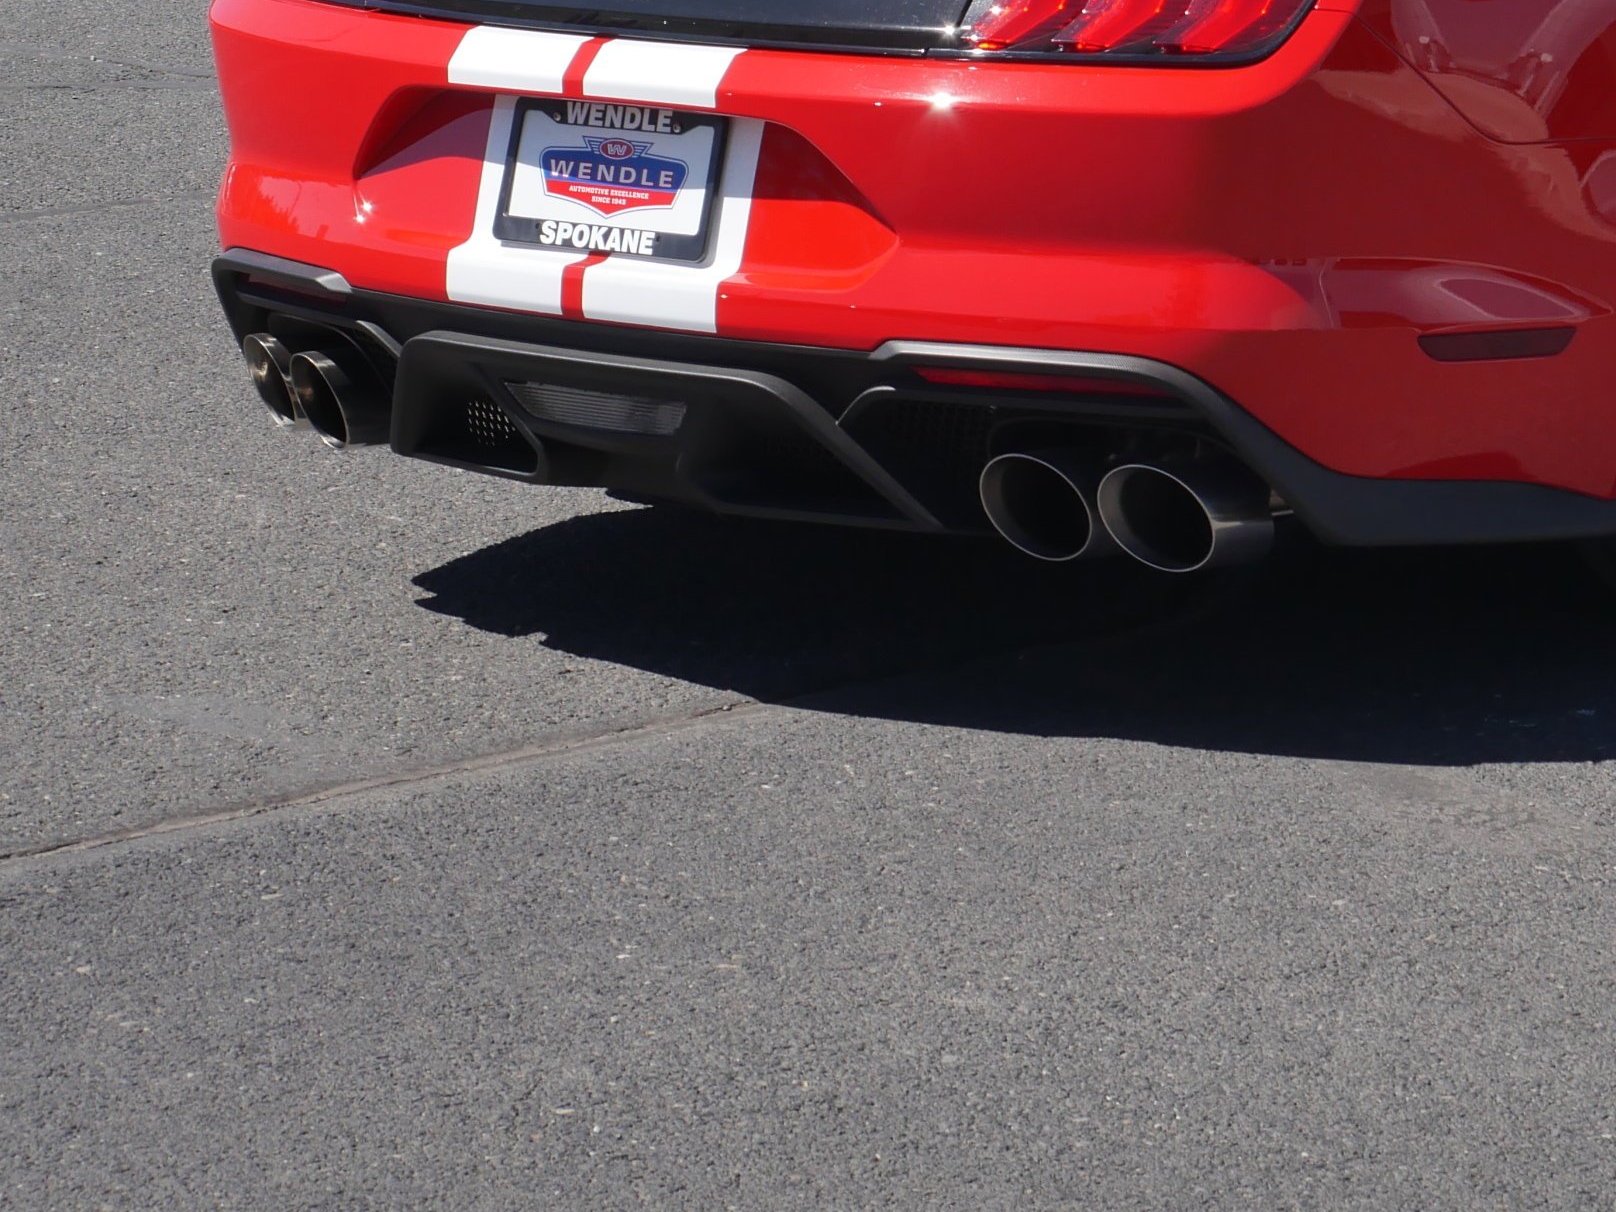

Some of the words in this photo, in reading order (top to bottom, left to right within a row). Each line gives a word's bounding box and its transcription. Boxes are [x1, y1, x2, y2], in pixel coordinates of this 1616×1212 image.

[566, 101, 674, 134] WENDLE
[550, 159, 674, 188] WENDLE
[568, 184, 610, 196] AUTOMOTIVE
[610, 189, 650, 200] EXCELLENCE
[591, 195, 611, 205] SINCE
[539, 220, 657, 255] SPOKANE
